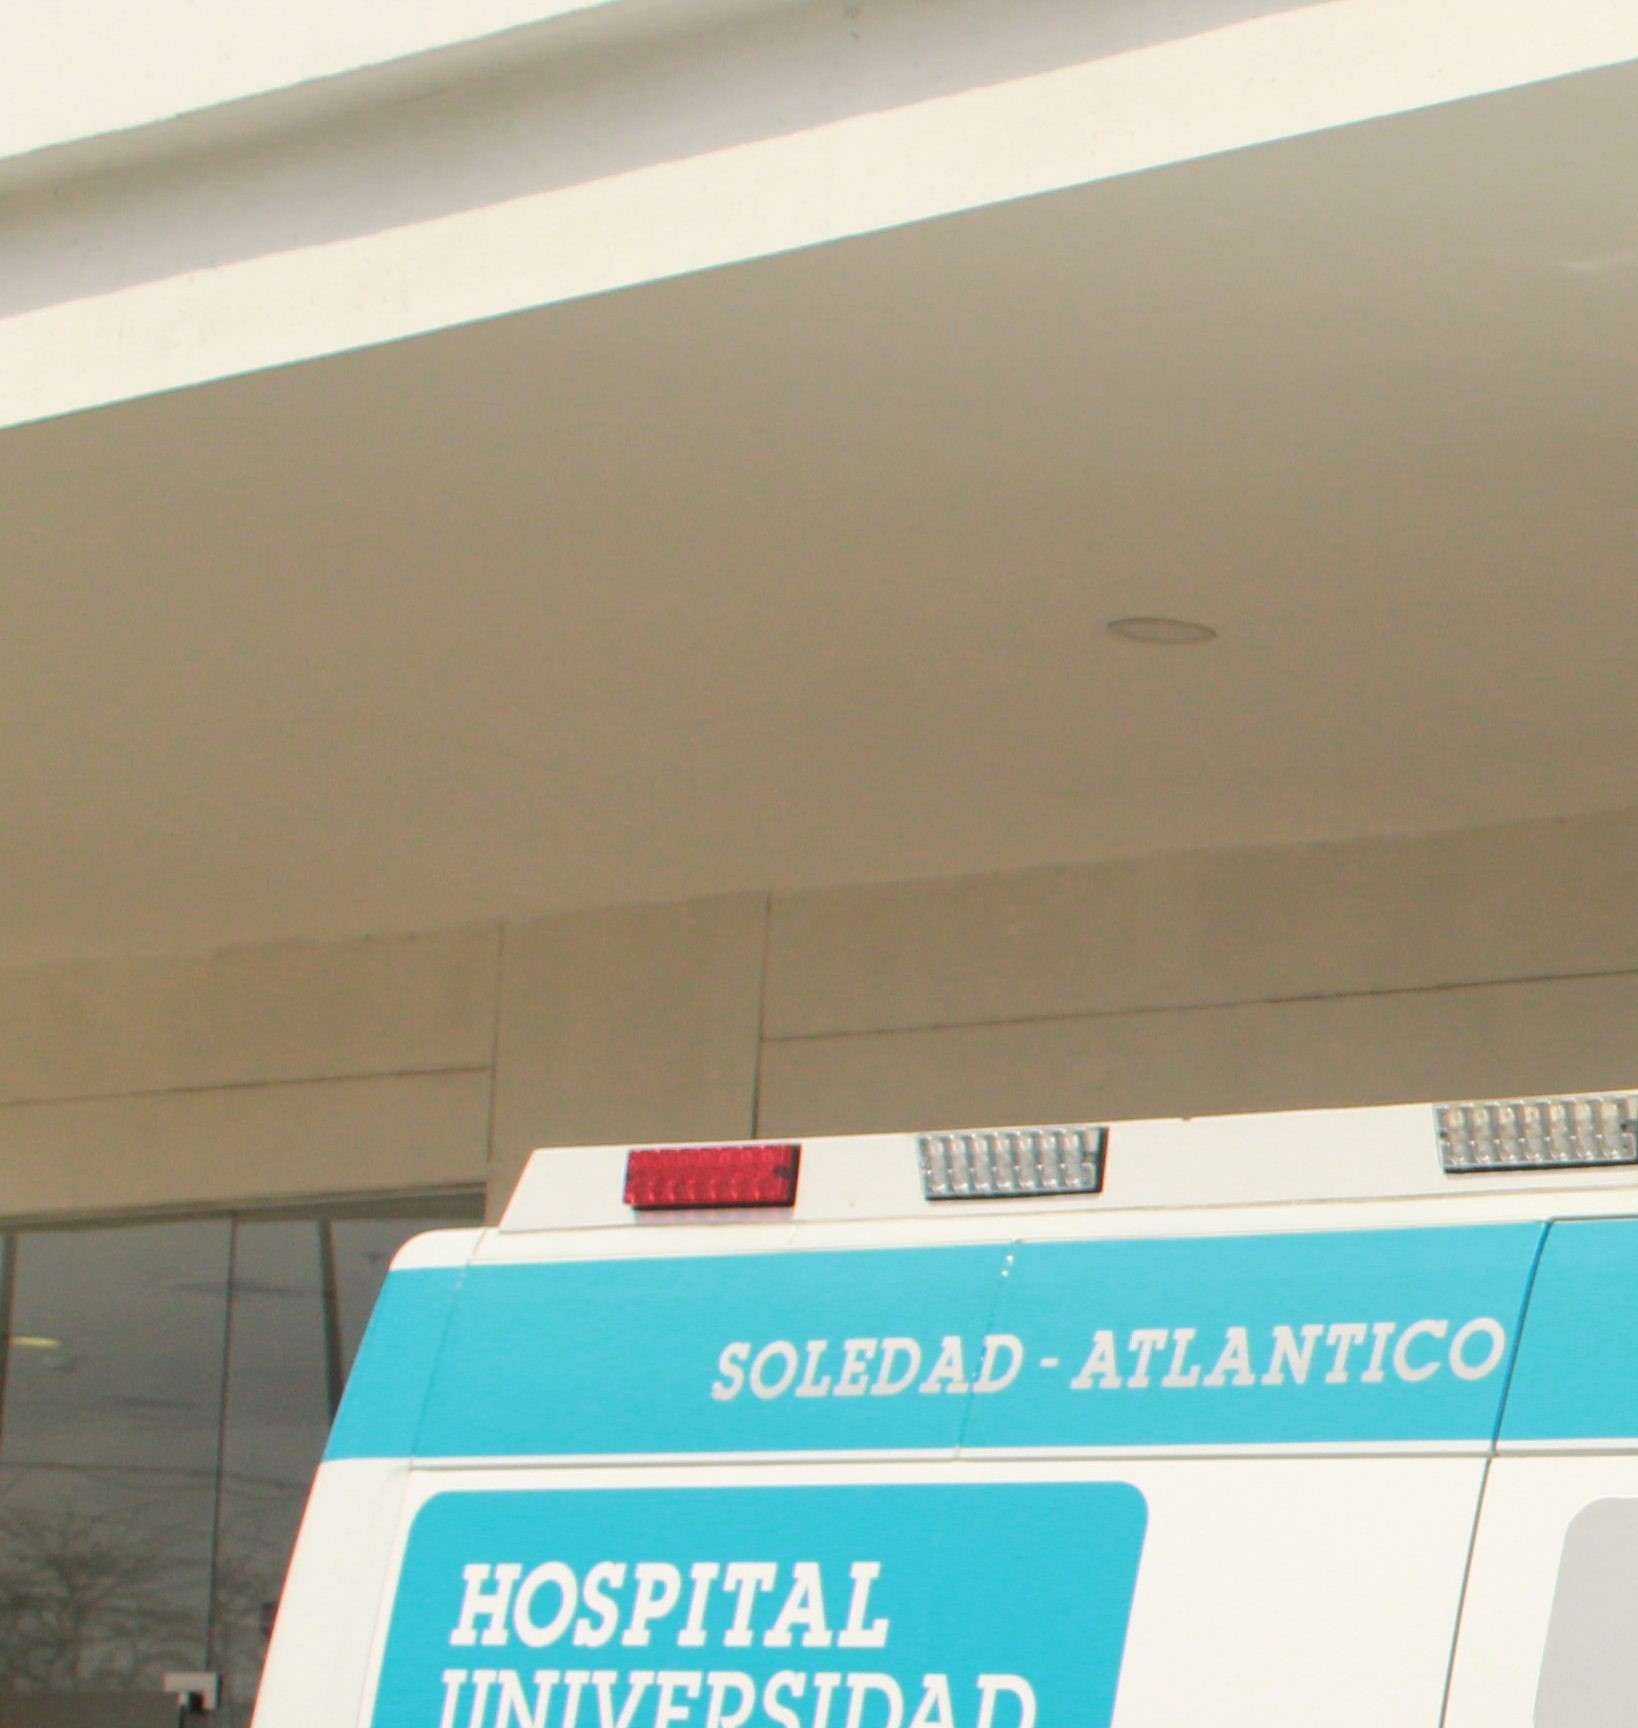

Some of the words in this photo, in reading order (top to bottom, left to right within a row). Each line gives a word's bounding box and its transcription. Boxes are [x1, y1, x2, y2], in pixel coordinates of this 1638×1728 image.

[711, 1334, 1024, 1400] SOLEDAD
[1070, 1317, 1507, 1390] ATLANTICO
[448, 1561, 889, 1648] HOSPITAL
